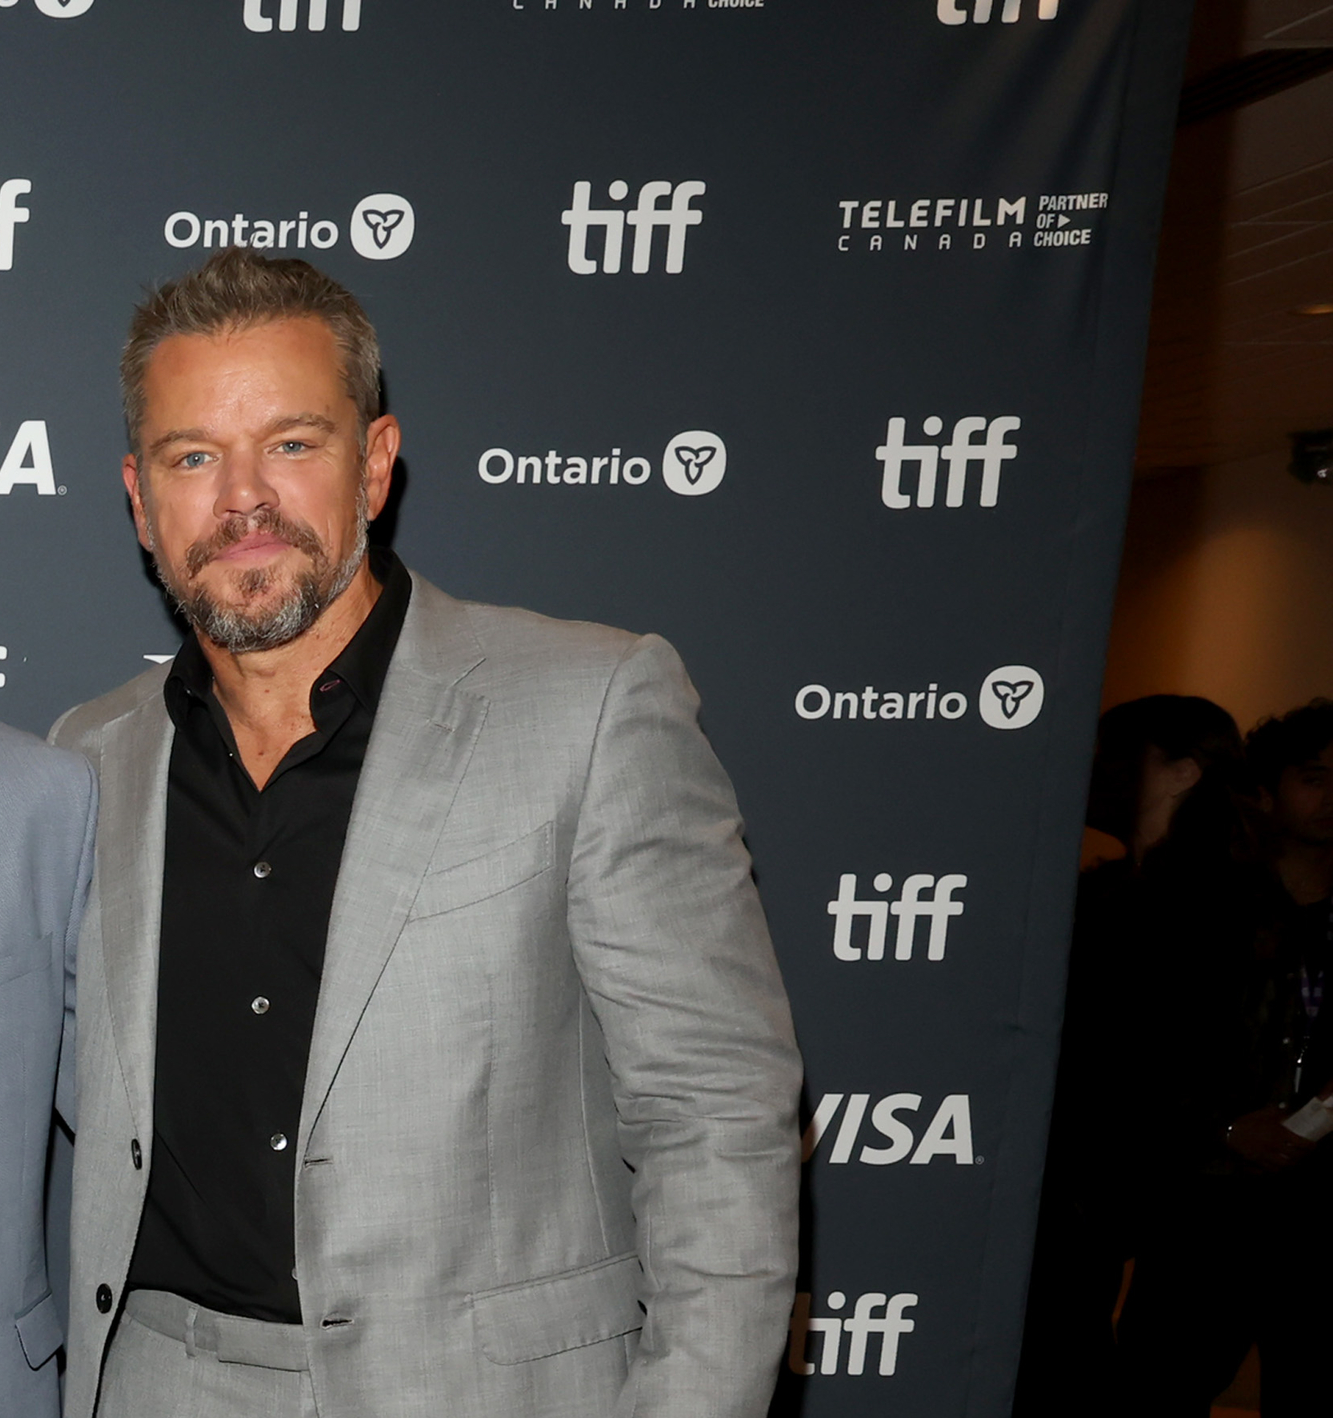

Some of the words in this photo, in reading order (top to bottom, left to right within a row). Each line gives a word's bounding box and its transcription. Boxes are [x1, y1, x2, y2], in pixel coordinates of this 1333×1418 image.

[838, 196, 1027, 229] TELEFILM
[1038, 192, 1108, 211] PARTNER
[164, 211, 339, 249] Ontario
[561, 180, 706, 275] tiff
[1033, 228, 1092, 247] CHOICE
[1036, 214, 1056, 229] OF
[838, 231, 1022, 252] CANADA
[478, 448, 651, 485] Ontario
[875, 415, 1021, 509] tiff
[794, 683, 968, 720] Ontario
[827, 872, 968, 962] tiff
